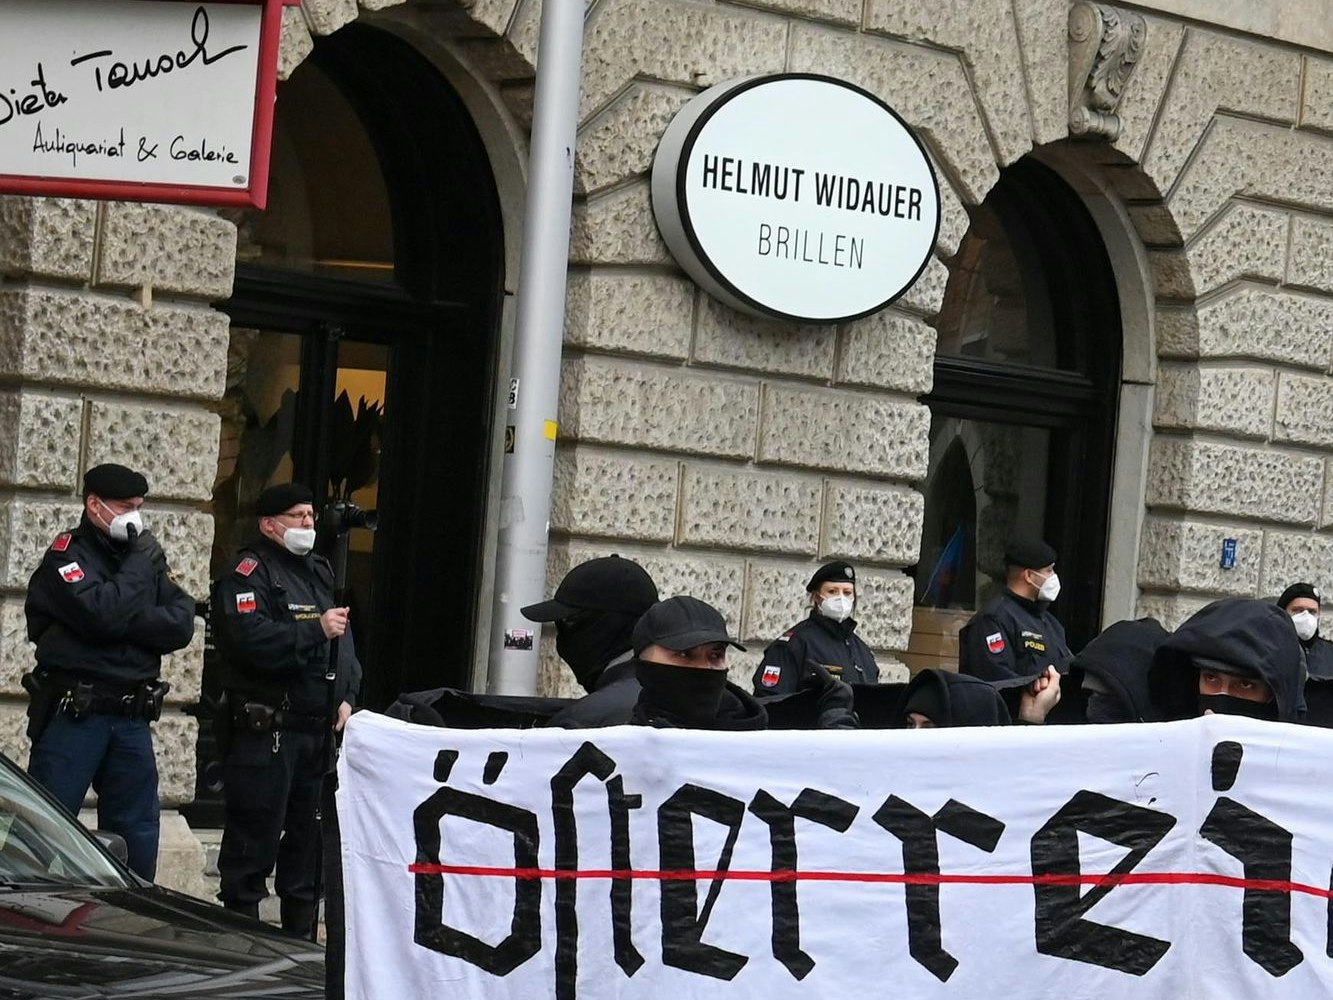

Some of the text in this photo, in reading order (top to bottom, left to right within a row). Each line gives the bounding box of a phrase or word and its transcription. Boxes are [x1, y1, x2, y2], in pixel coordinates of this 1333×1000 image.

[33, 121, 239, 168] Antiquariat & Galerie
[703, 154, 923, 221] HELMUT WIDAUER
[758, 223, 864, 270] BRILLEN
